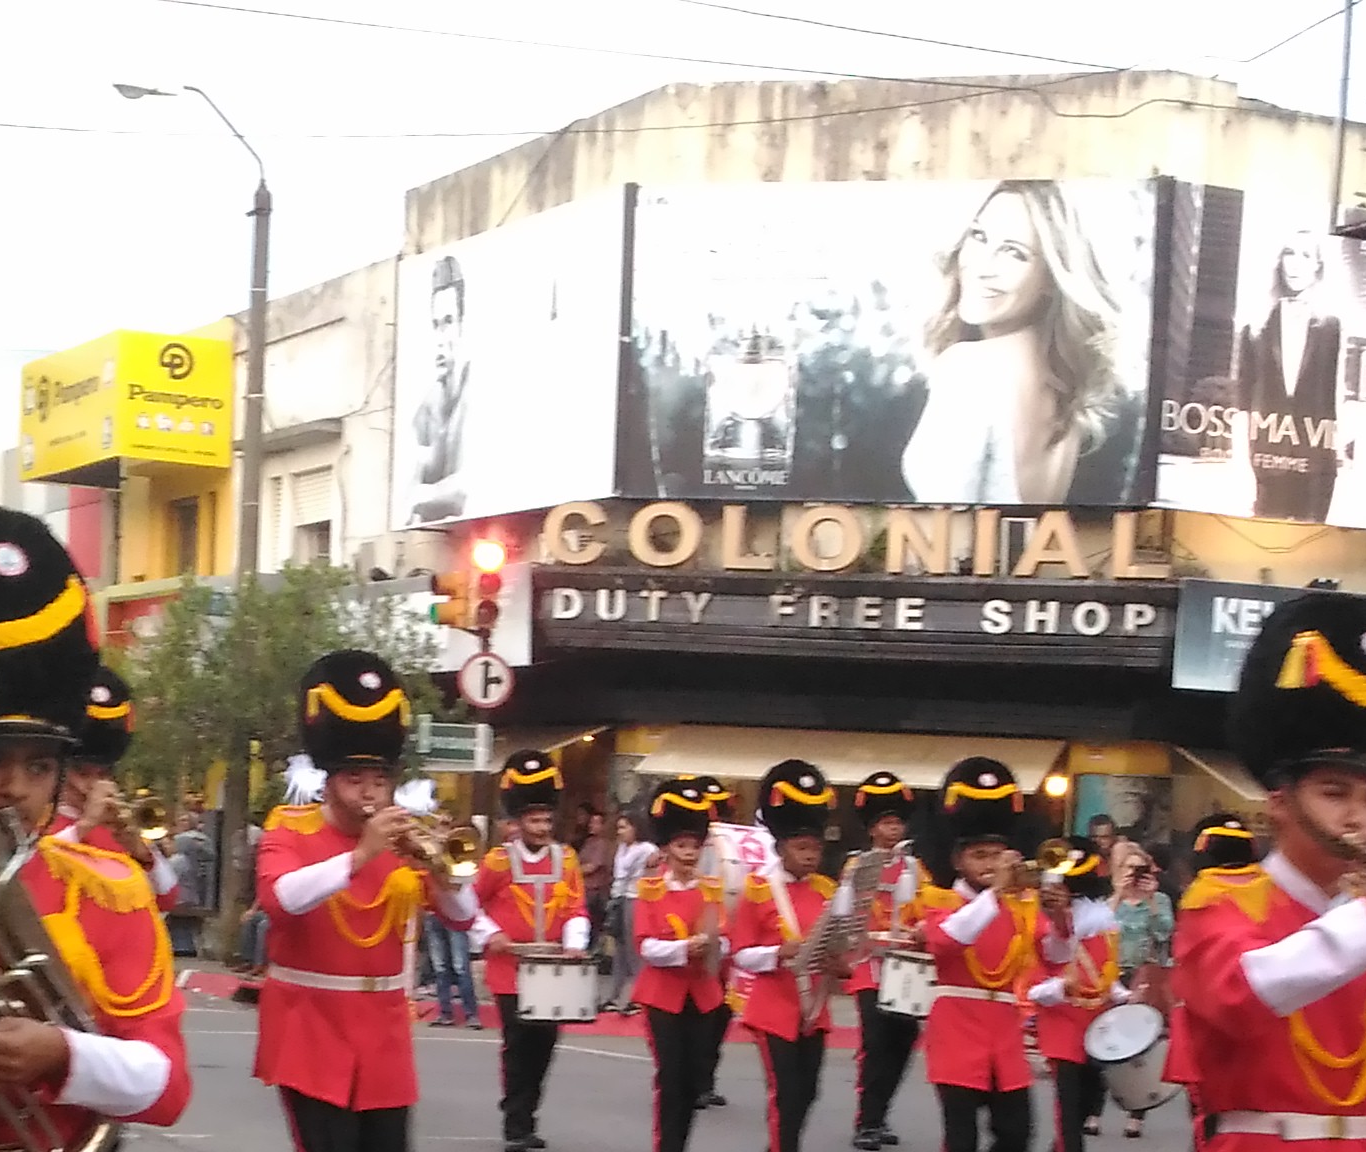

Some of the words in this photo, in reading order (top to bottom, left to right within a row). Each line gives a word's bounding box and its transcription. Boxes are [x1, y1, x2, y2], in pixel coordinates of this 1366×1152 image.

[128, 384, 223, 410] Pampero
[1161, 399, 1240, 439] BOSS
[1249, 410, 1300, 446] MA
[1303, 416, 1338, 451] VI
[1252, 453, 1310, 473] FEMME
[542, 500, 1172, 580] COLONIAL
[550, 587, 713, 624] DUTY
[768, 593, 926, 631] FREE
[980, 599, 1158, 636] SHOP
